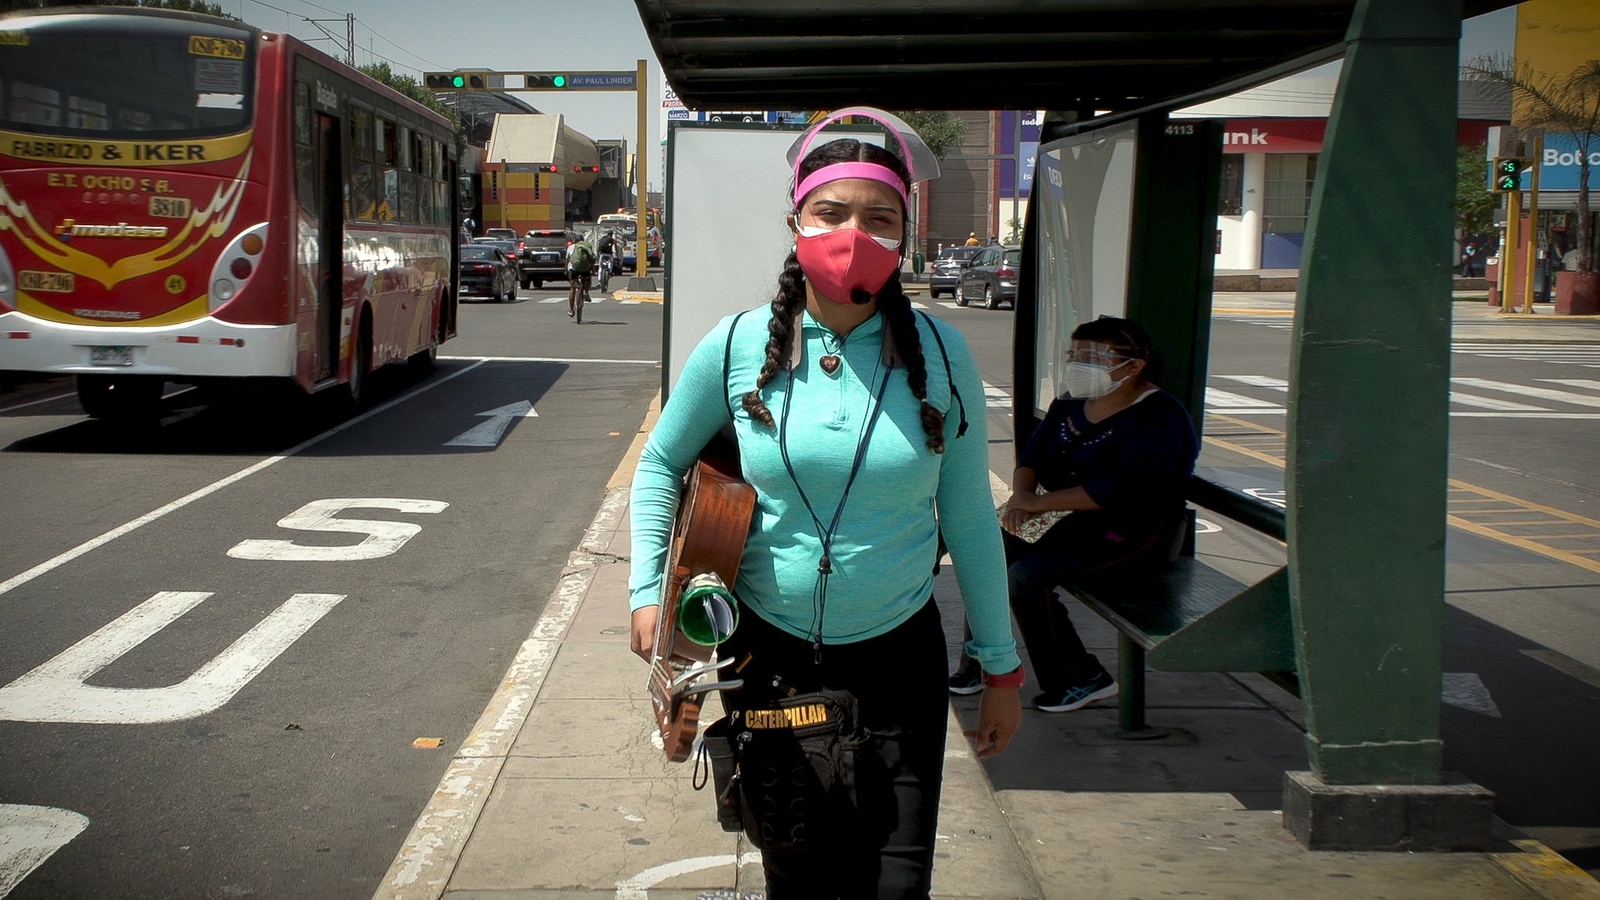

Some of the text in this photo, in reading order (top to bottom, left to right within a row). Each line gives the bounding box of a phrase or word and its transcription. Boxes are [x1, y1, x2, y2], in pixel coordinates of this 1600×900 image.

[572, 77, 633, 85] AV. PAUL LINDER
[1165, 125, 1194, 135] 4113
[12, 140, 206, 161] FABRIZIO & IKER
[82, 175, 135, 191] OCHO
[745, 703, 827, 729] CATERPILLAR
